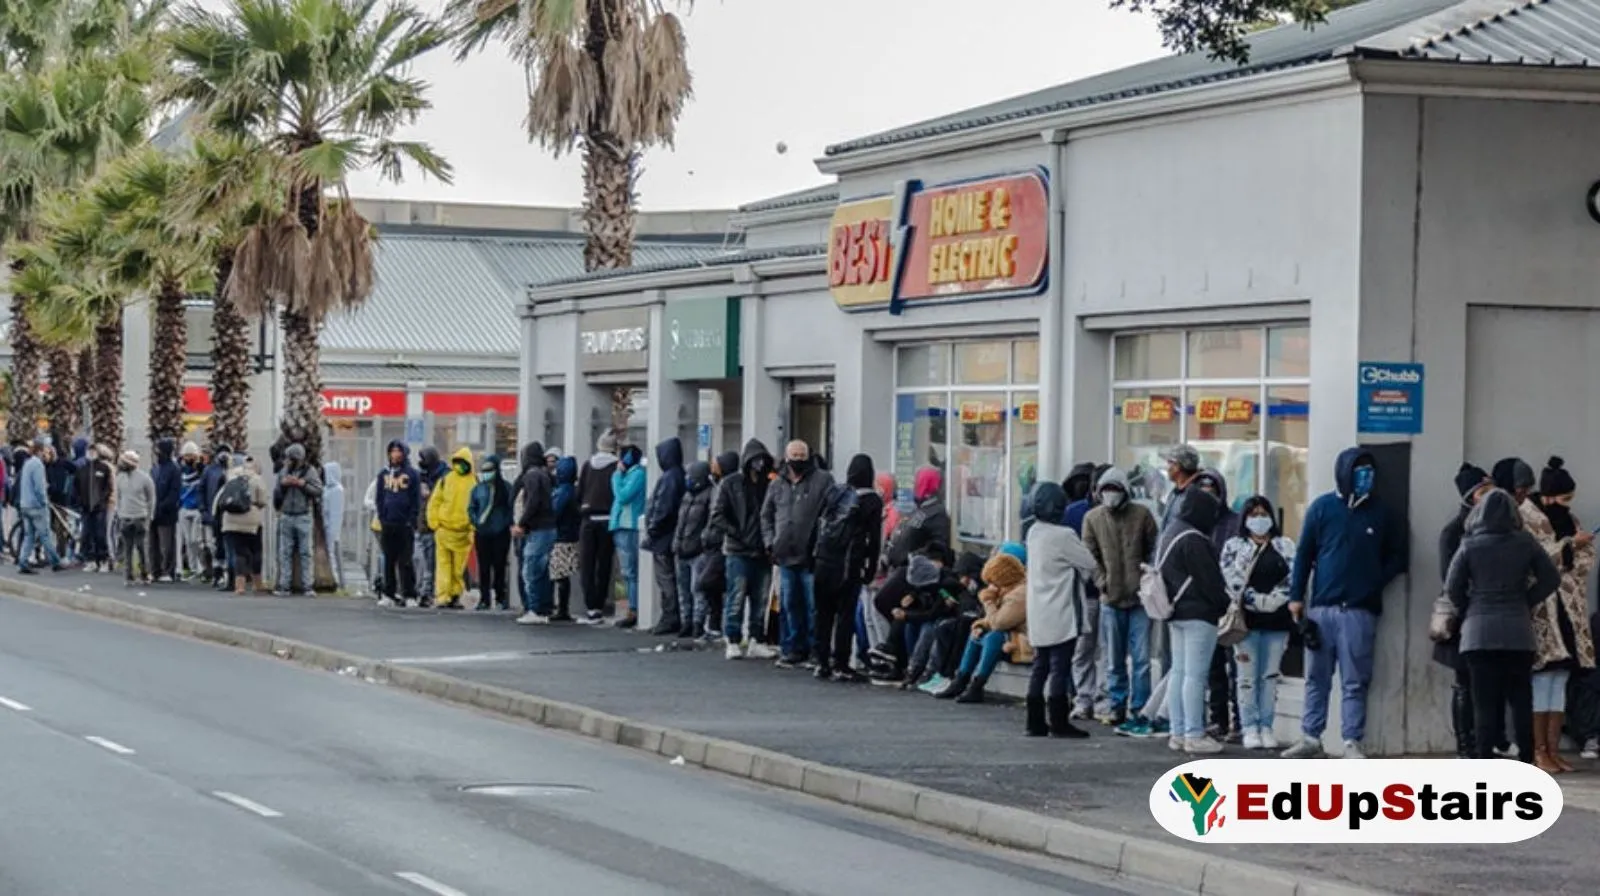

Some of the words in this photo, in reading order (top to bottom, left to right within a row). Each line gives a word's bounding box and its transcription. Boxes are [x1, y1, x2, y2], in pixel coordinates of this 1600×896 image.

[928, 191, 991, 239] HOME
[990, 187, 1013, 230] &
[830, 219, 894, 287] BEST
[927, 234, 1018, 286] ELECTRIC
[1377, 368, 1420, 383] Chubb
[332, 395, 373, 414] mrp
